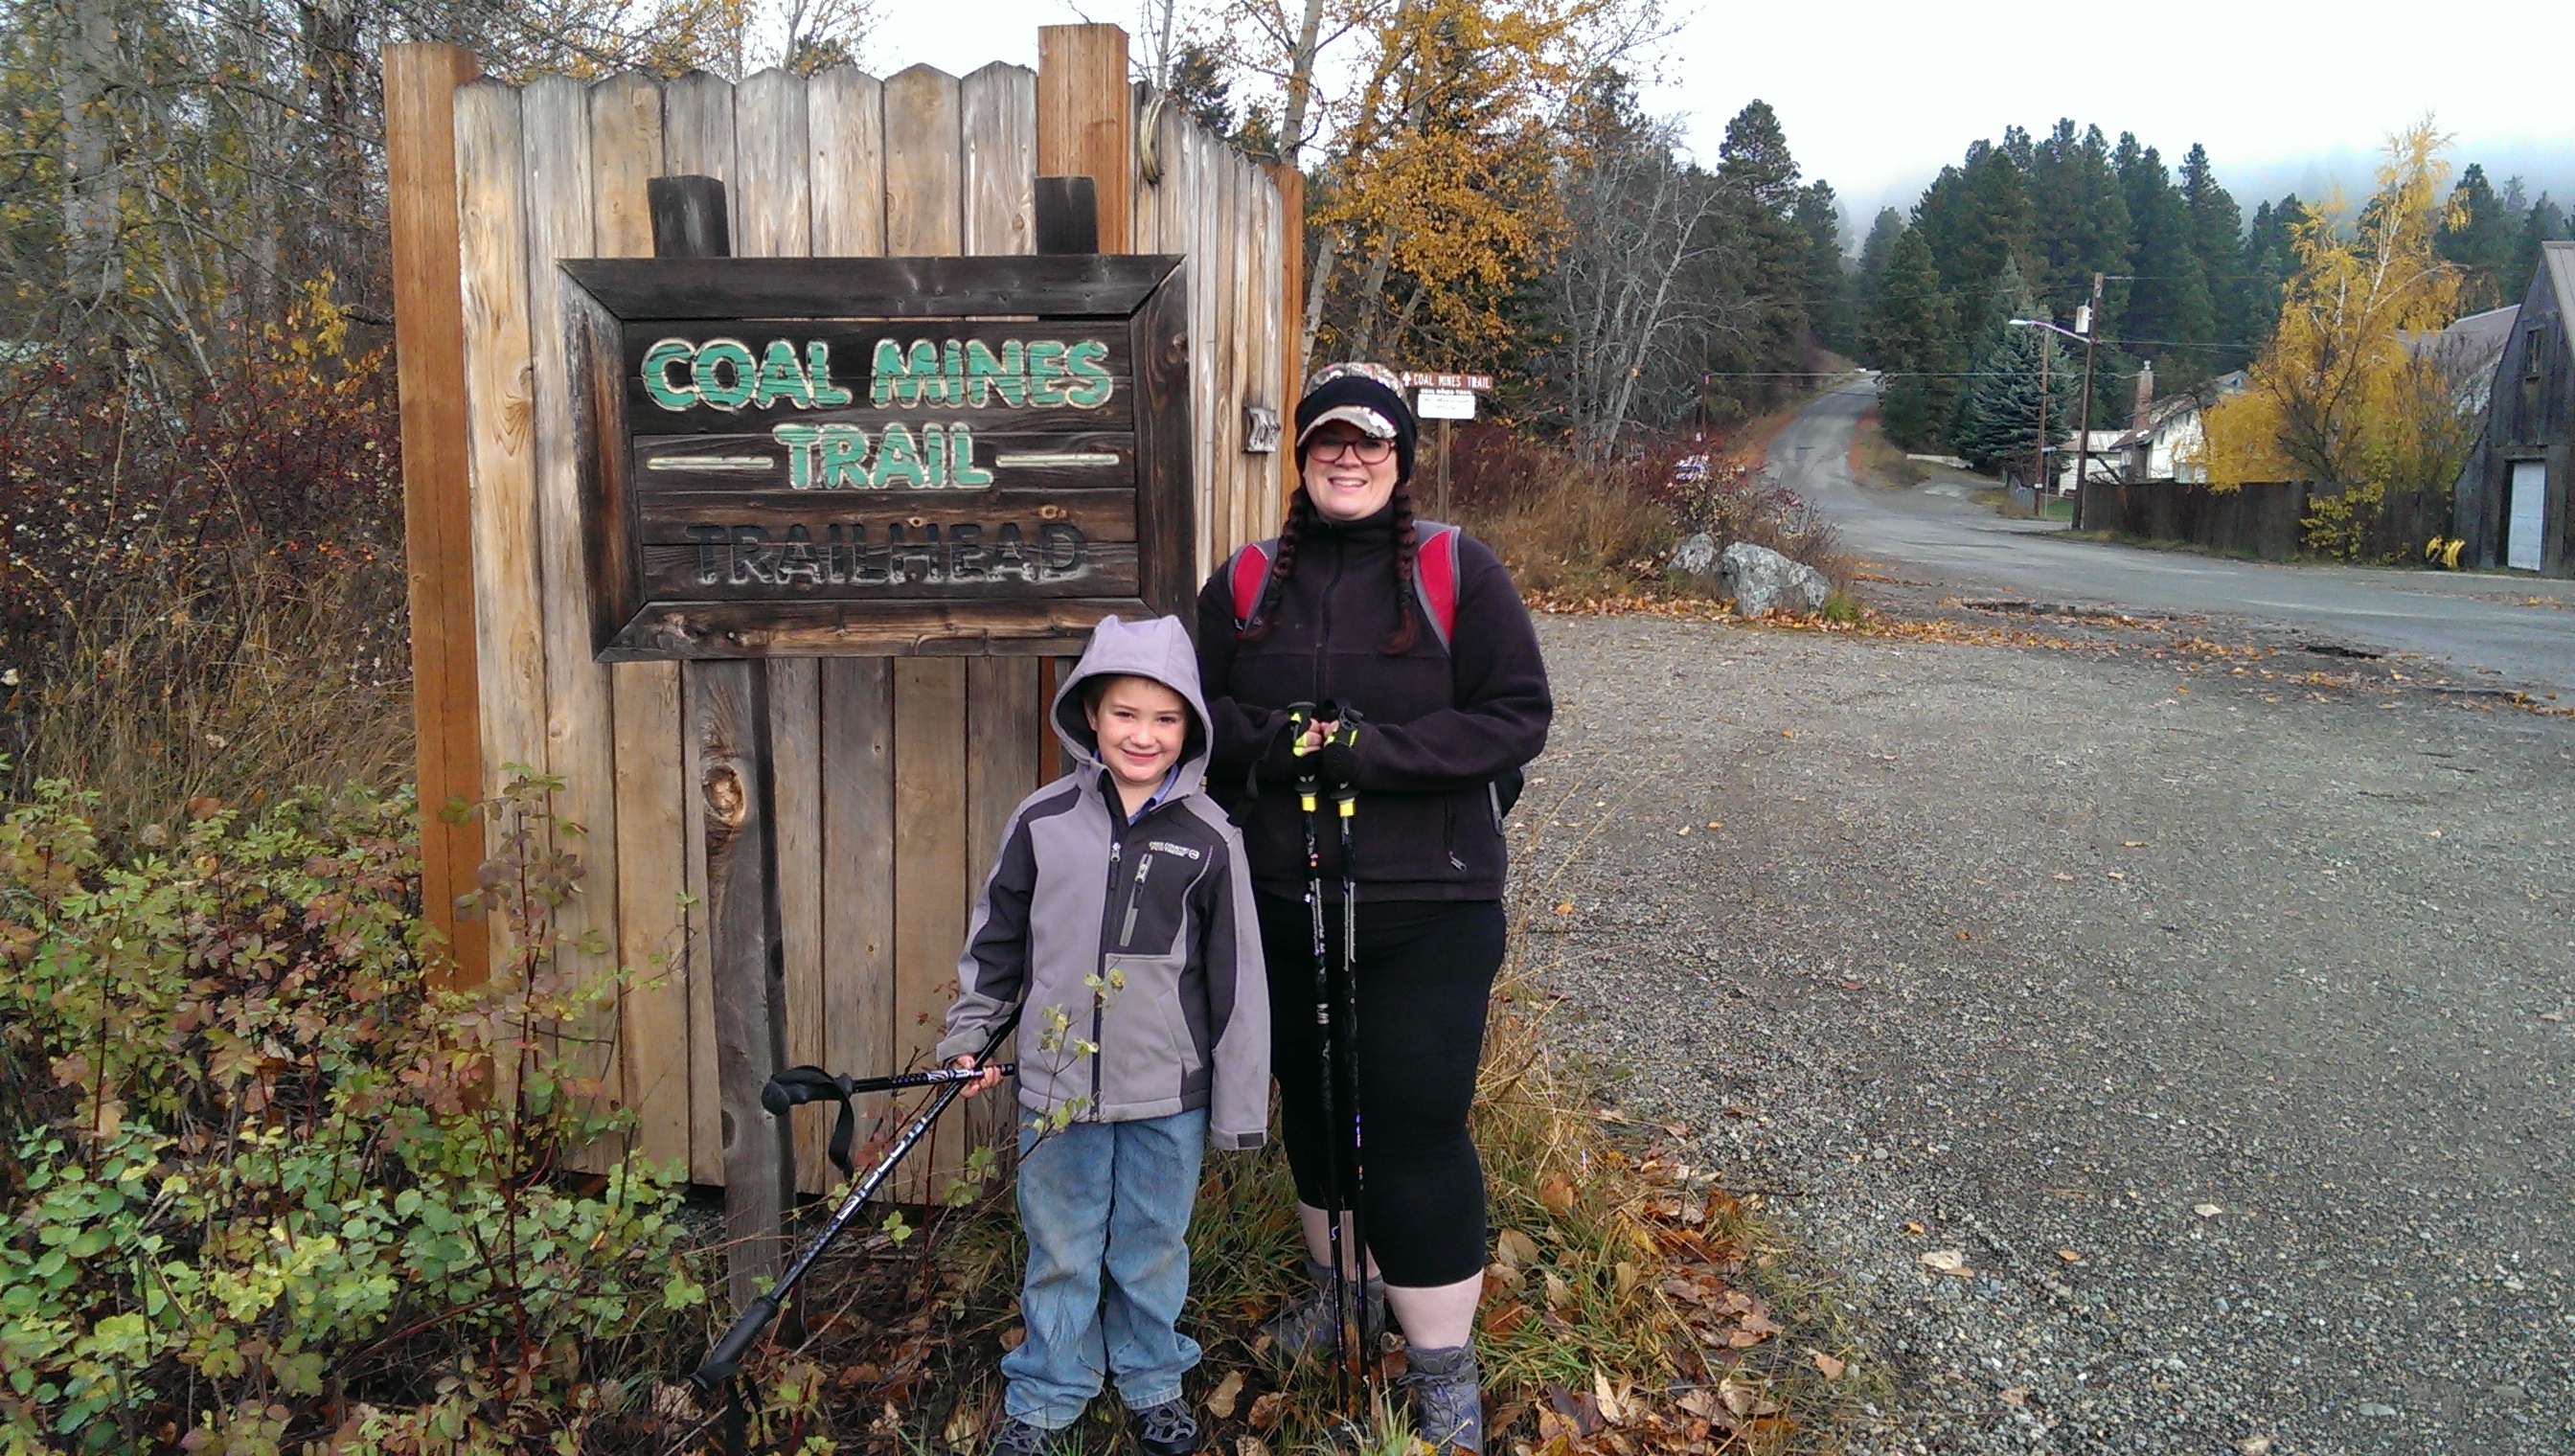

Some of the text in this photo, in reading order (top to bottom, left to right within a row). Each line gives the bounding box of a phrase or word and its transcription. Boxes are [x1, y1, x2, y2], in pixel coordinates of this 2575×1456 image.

[641, 337, 1114, 412] COAL MINES
[1413, 373, 1491, 389] COAL MINES TRAIL
[772, 421, 993, 490] TRAIL
[685, 523, 1089, 586] TRAILHEAD
